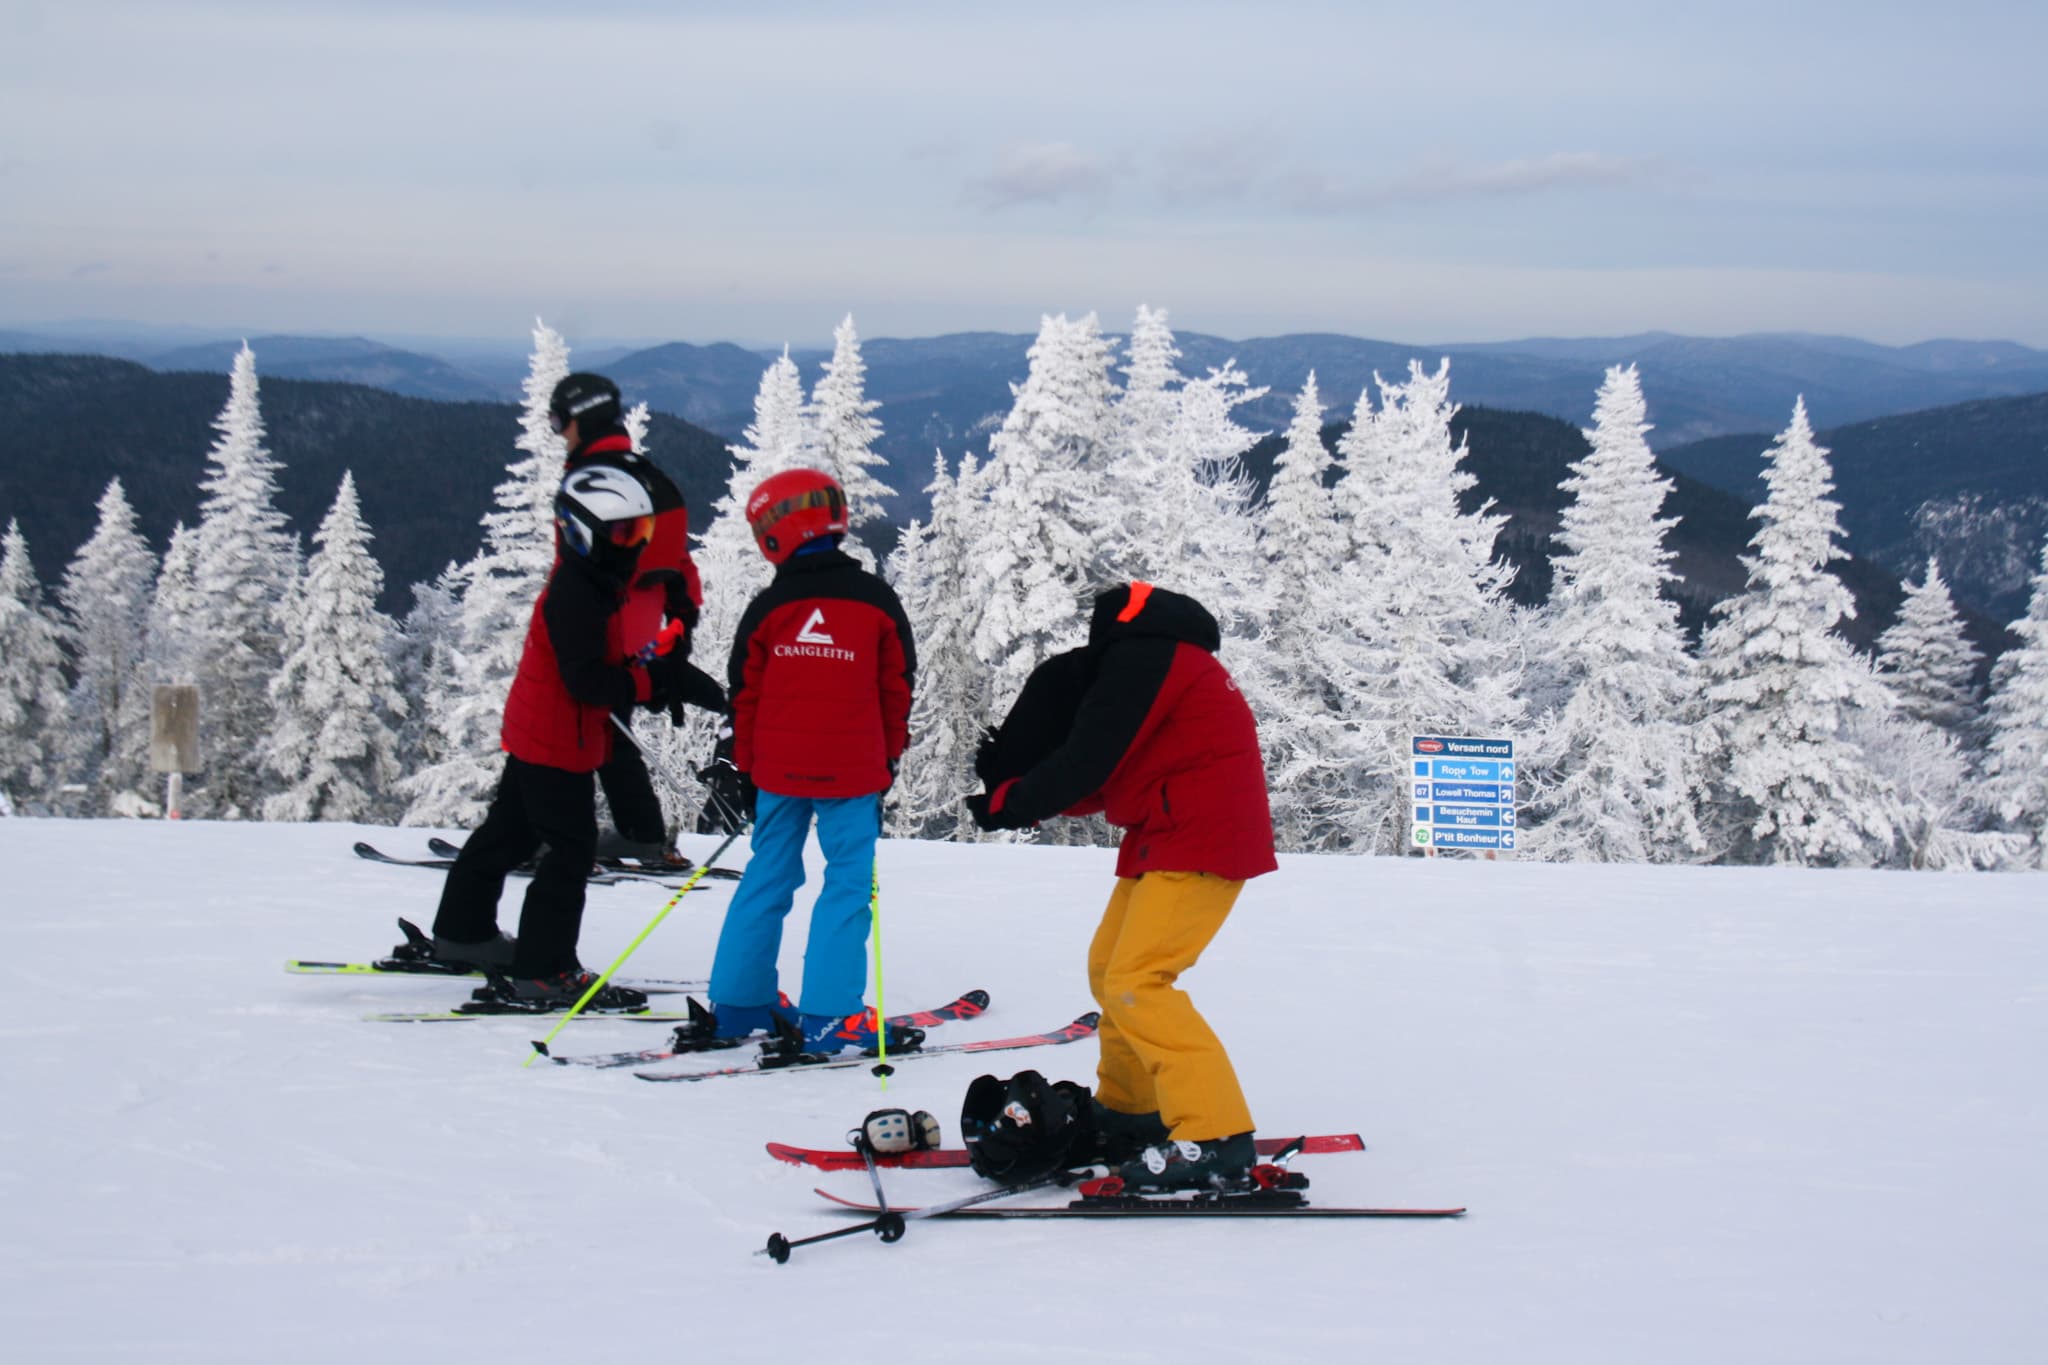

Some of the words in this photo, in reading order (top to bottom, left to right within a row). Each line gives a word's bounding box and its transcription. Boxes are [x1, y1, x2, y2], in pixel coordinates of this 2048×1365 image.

[774, 644, 855, 662] CRAIGLEITH
[1447, 742, 1485, 753] Versant
[1486, 744, 1509, 754] nord
[1441, 765, 1467, 778] Rope
[1470, 766, 1489, 776] Tow
[1435, 788, 1462, 797] Lowell
[1464, 789, 1496, 798] Thomas
[1440, 806, 1493, 817] Beauchemin
[1456, 816, 1477, 824] Haut
[1435, 832, 1455, 841] P'tit
[1456, 833, 1498, 844] Bonheur
